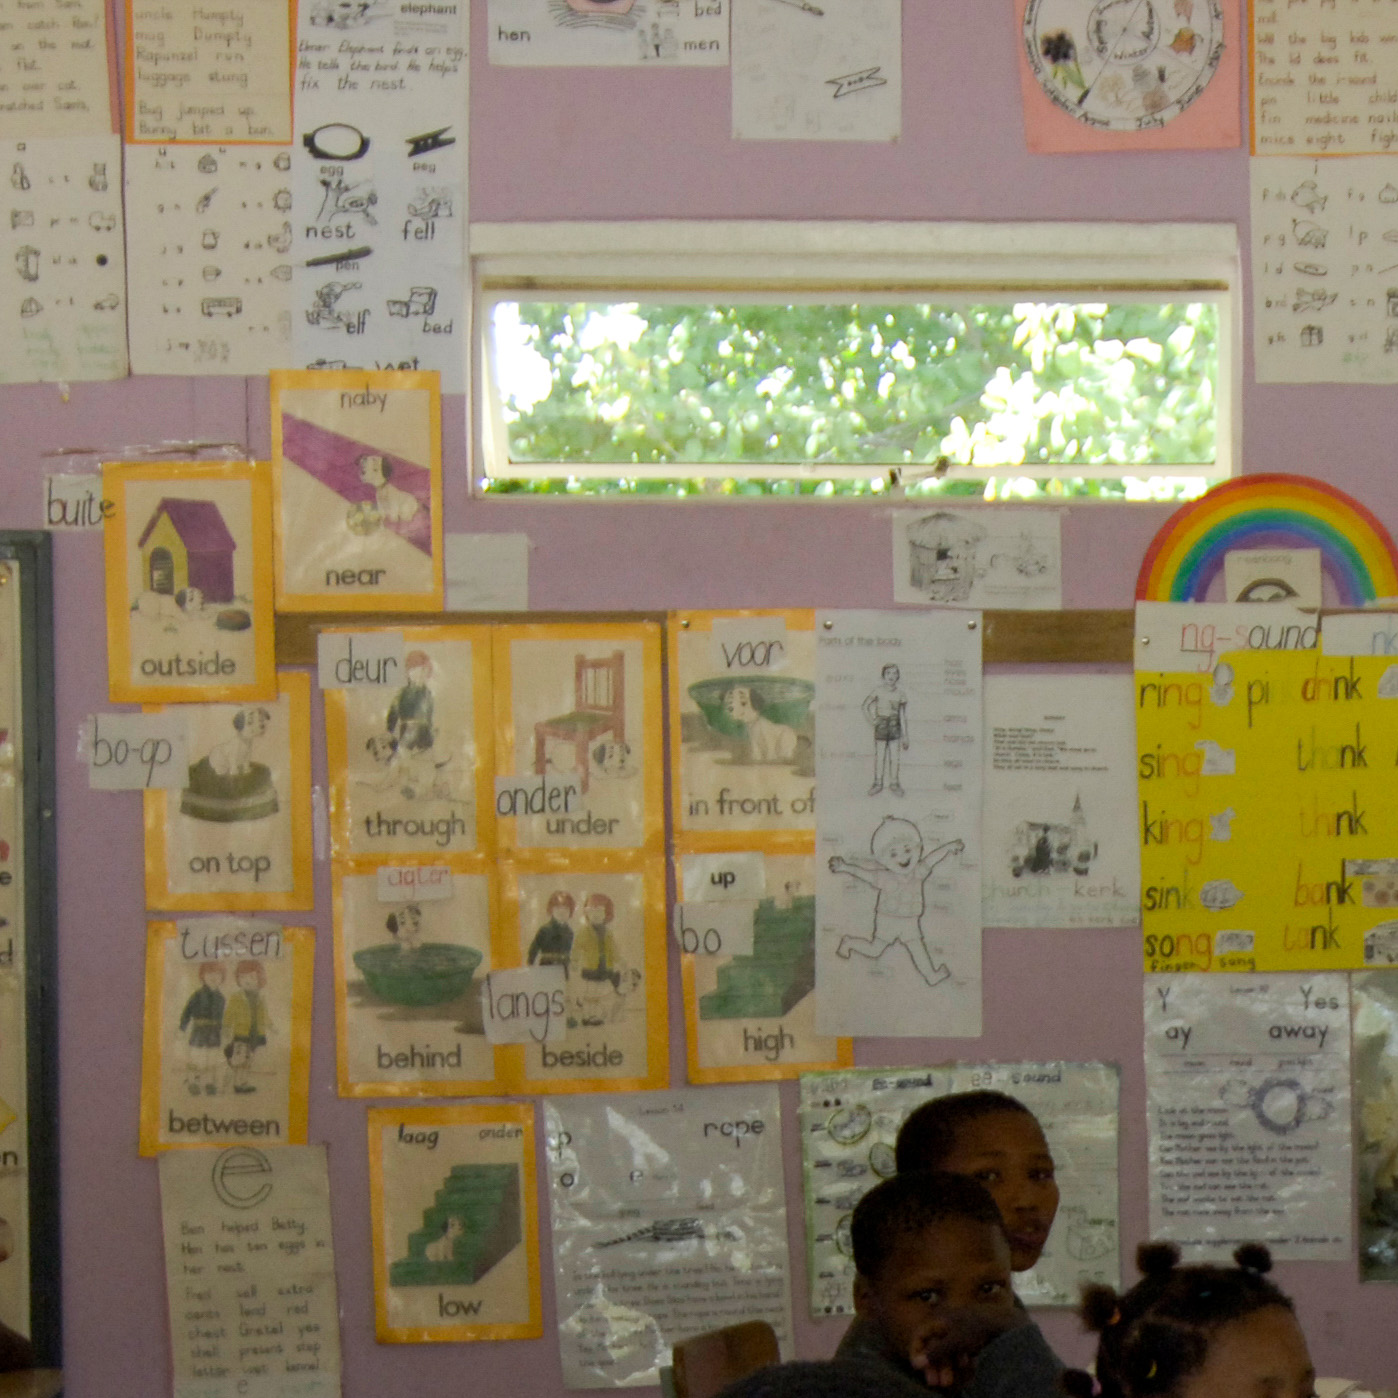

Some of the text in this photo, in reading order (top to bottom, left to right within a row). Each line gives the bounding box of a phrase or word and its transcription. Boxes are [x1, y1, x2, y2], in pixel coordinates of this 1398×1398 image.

[401, 3, 456, 16] elephant
[684, 38, 720, 52] men
[319, 164, 344, 177] egg
[412, 162, 437, 174] peg
[305, 223, 356, 239] nest
[402, 219, 436, 241] fell
[335, 259, 360, 273] pen
[346, 309, 371, 335] elf
[422, 318, 453, 335] bed
[339, 384, 388, 413] naby
[46, 478, 116, 527] buite
[324, 565, 387, 587] near
[1370, 614, 1398, 655] nk
[140, 651, 237, 677] outside
[335, 637, 398, 685] deur
[721, 638, 785, 668] voor
[1140, 656, 1363, 730] ring drink
[496, 777, 577, 816] onder
[688, 787, 815, 817] in front of
[364, 811, 467, 848] through
[546, 811, 620, 837] under
[1143, 800, 1204, 866] king
[189, 851, 271, 883] on top
[710, 870, 736, 889] up
[1294, 857, 1357, 908] bank
[680, 904, 722, 954] bo
[179, 927, 282, 961] tussen
[1145, 931, 1213, 972] song
[486, 972, 566, 1043] langs
[1300, 984, 1340, 1011] Yes
[743, 1026, 795, 1061] high
[1165, 1026, 1192, 1050] ay
[1268, 1024, 1329, 1049] away
[377, 1042, 463, 1070] behind
[541, 1042, 624, 1070] beside
[168, 1108, 281, 1136] between
[397, 1122, 440, 1150] laag
[703, 1118, 766, 1149] rope
[211, 1145, 274, 1211] e
[437, 1293, 483, 1317] low
